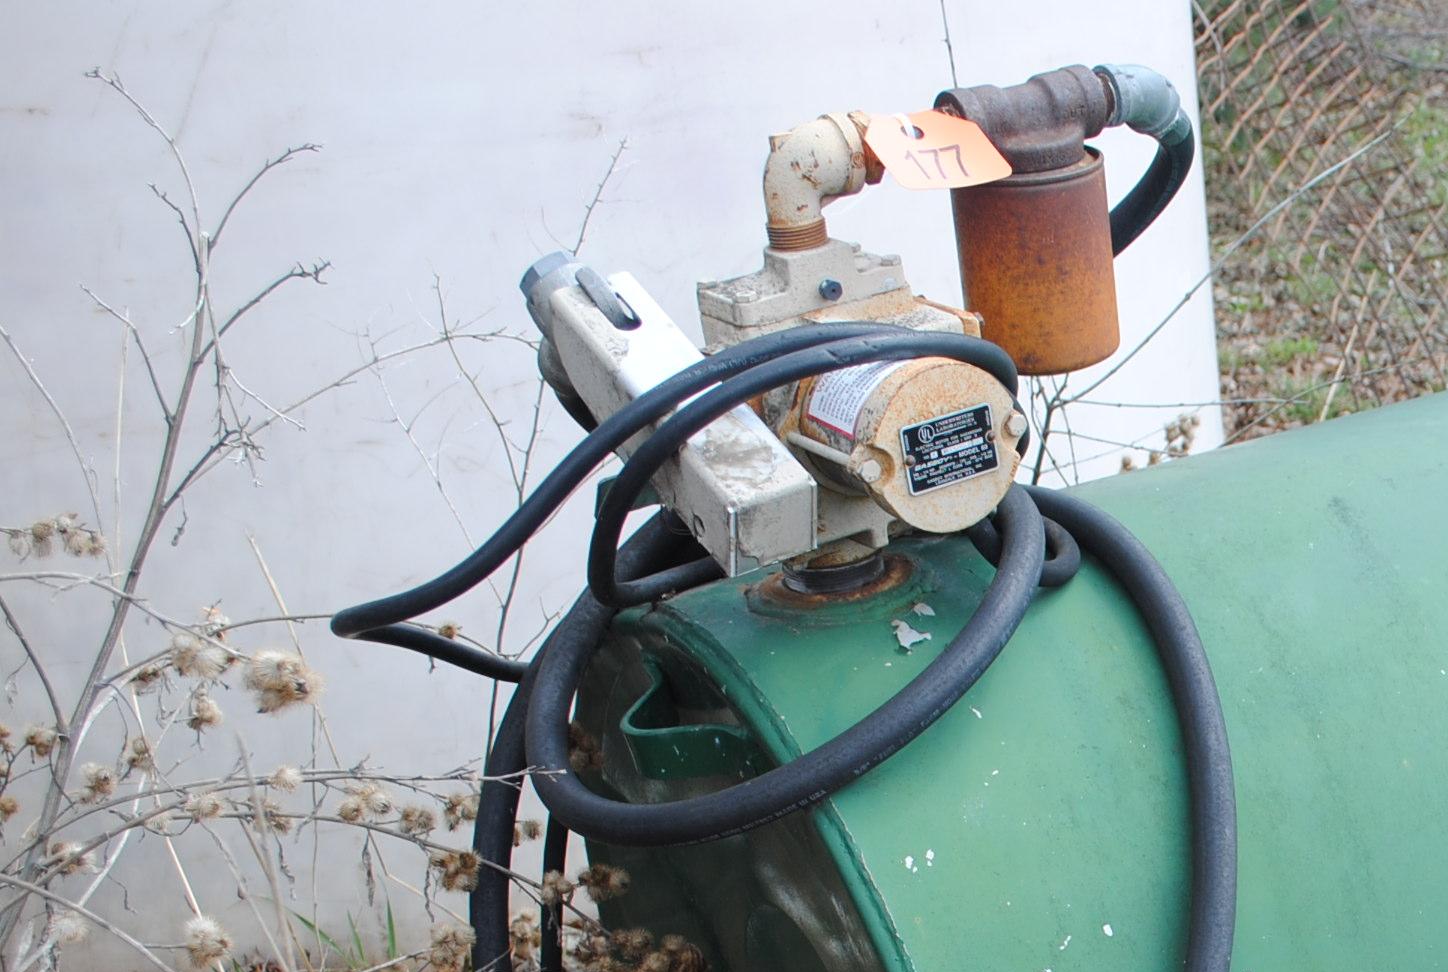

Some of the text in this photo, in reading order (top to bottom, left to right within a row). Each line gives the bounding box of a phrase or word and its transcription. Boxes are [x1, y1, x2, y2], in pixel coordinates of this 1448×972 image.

[904, 143, 971, 181] 177
[921, 426, 933, 443] UL
[958, 448, 980, 458] MODEL
